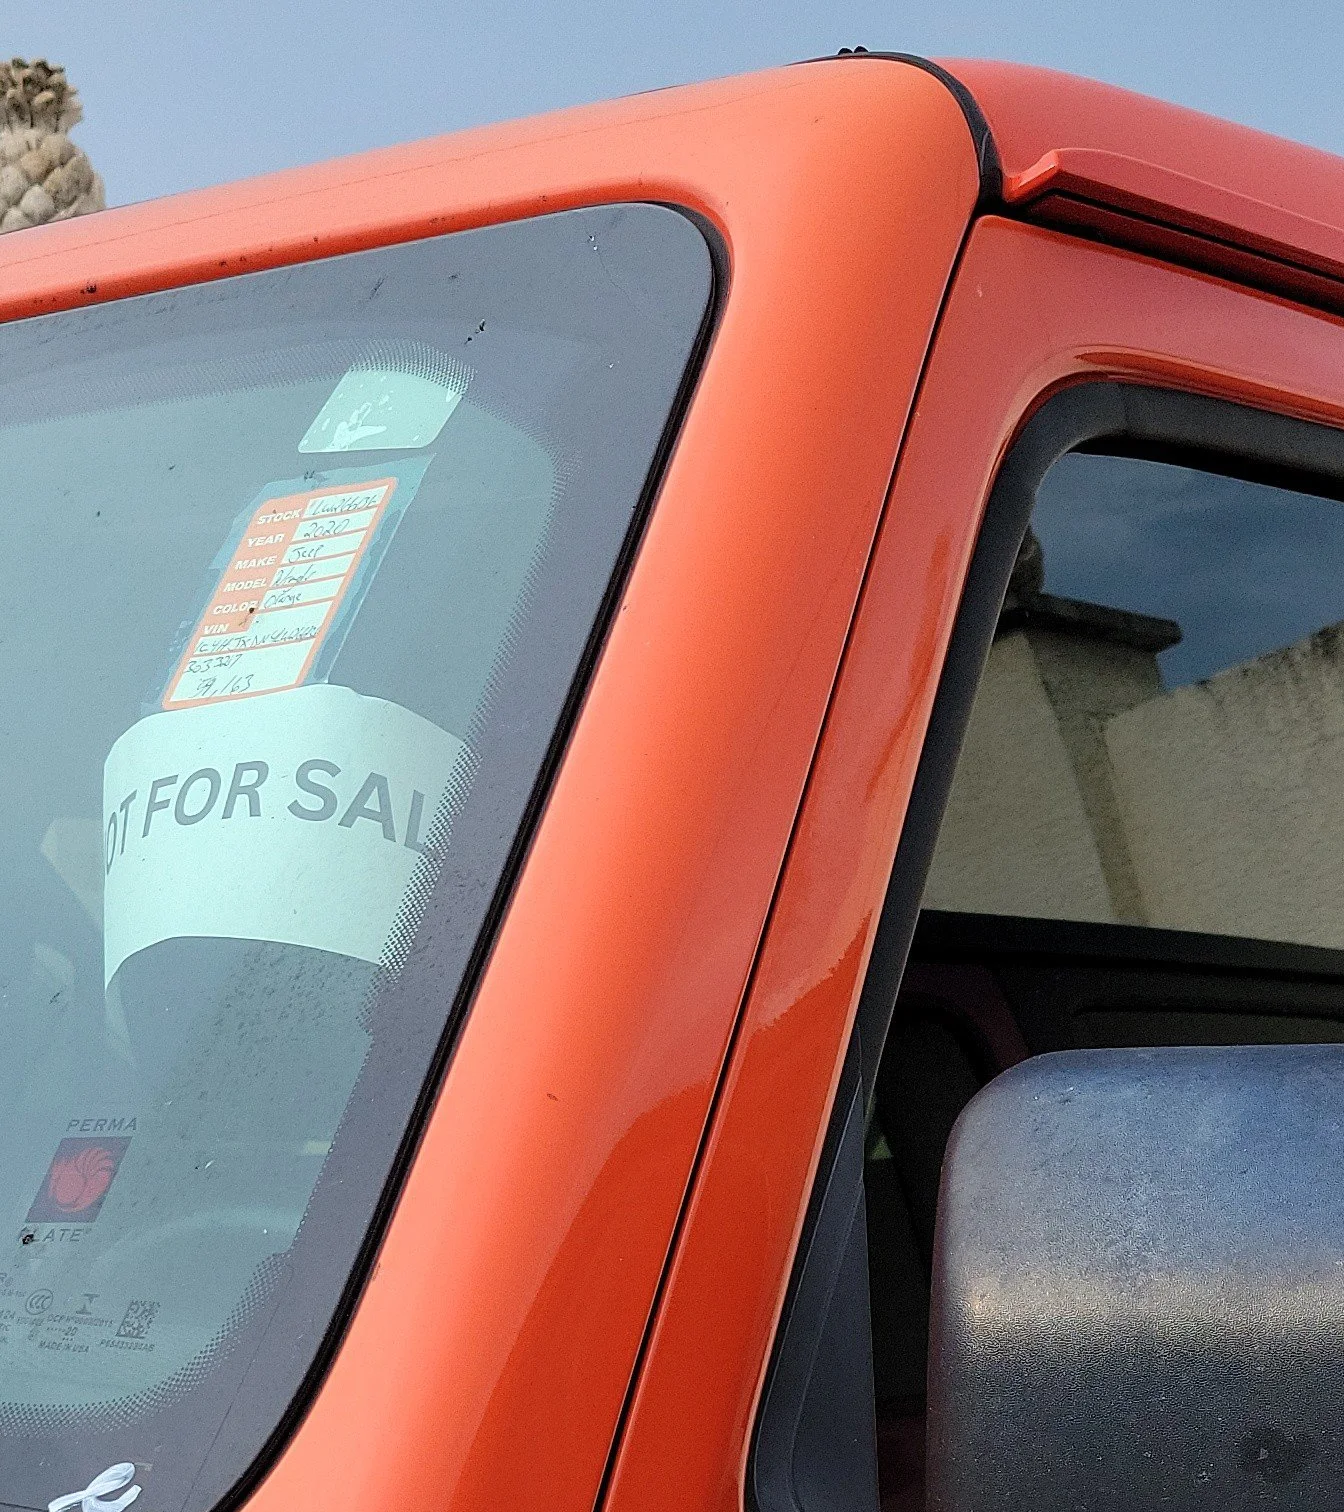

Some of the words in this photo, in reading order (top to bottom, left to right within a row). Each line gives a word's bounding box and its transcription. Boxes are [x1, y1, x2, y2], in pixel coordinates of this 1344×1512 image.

[257, 508, 304, 524] STOCK
[303, 518, 350, 538] 2020
[247, 533, 285, 548] YEAR
[234, 555, 278, 570] MAKE
[222, 577, 268, 593] MODEL
[212, 600, 260, 615] COLOR
[203, 623, 230, 635] VIN
[141, 760, 270, 839] FOR
[66, 1117, 138, 1133] PERMA
